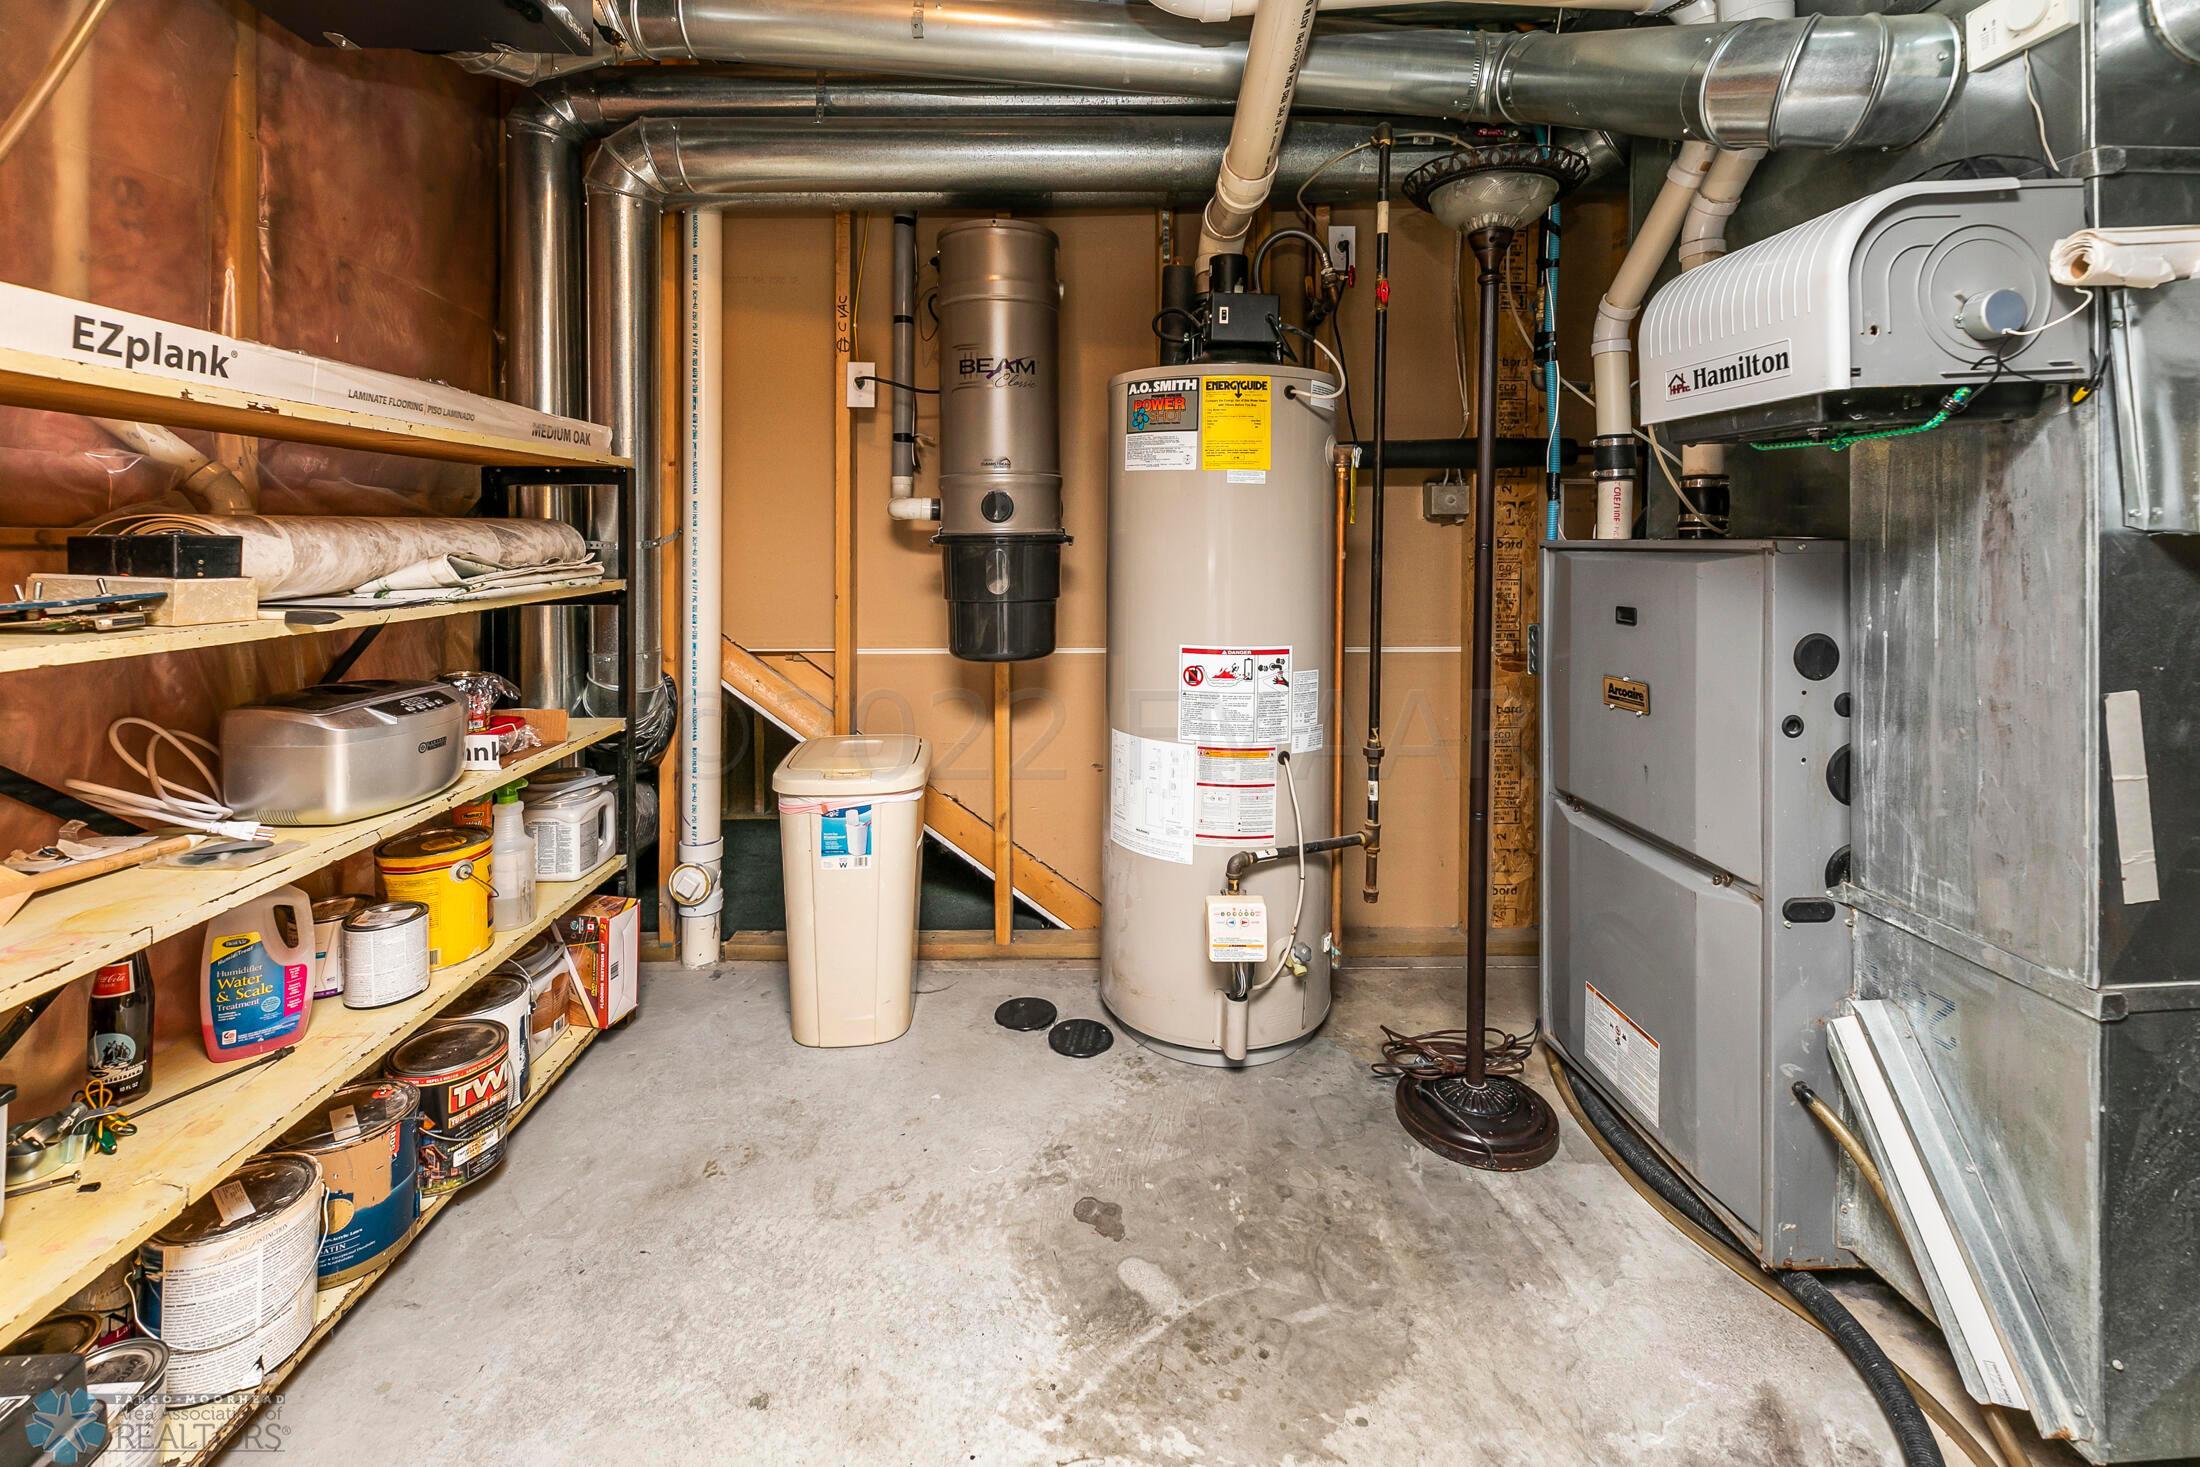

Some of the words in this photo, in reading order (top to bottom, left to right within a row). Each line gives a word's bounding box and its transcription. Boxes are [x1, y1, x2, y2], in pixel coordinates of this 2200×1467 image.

[959, 358, 1036, 376] BEAM
[1693, 351, 1790, 391] Hamilton
[995, 373, 1038, 388] Classic
[1128, 382, 1152, 395] A.O.
[1153, 379, 1197, 392] SMITH
[1205, 381, 1268, 391] ENERGYGUIDE
[348, 389, 388, 405] LAMINATE
[388, 397, 424, 412] FLOORING
[427, 405, 442, 416] PISO
[442, 407, 475, 422] LAMINADO
[1133, 397, 1186, 411] POWER
[531, 422, 571, 443] MEDIUM
[573, 430, 591, 446] OAK
[1608, 683, 1645, 702] Arcoaire
[216, 965, 263, 978] Humidifier
[217, 974, 263, 989] Water
[216, 992, 230, 1003] &
[236, 984, 273, 1000] Scale
[216, 998, 260, 1012] Treatment
